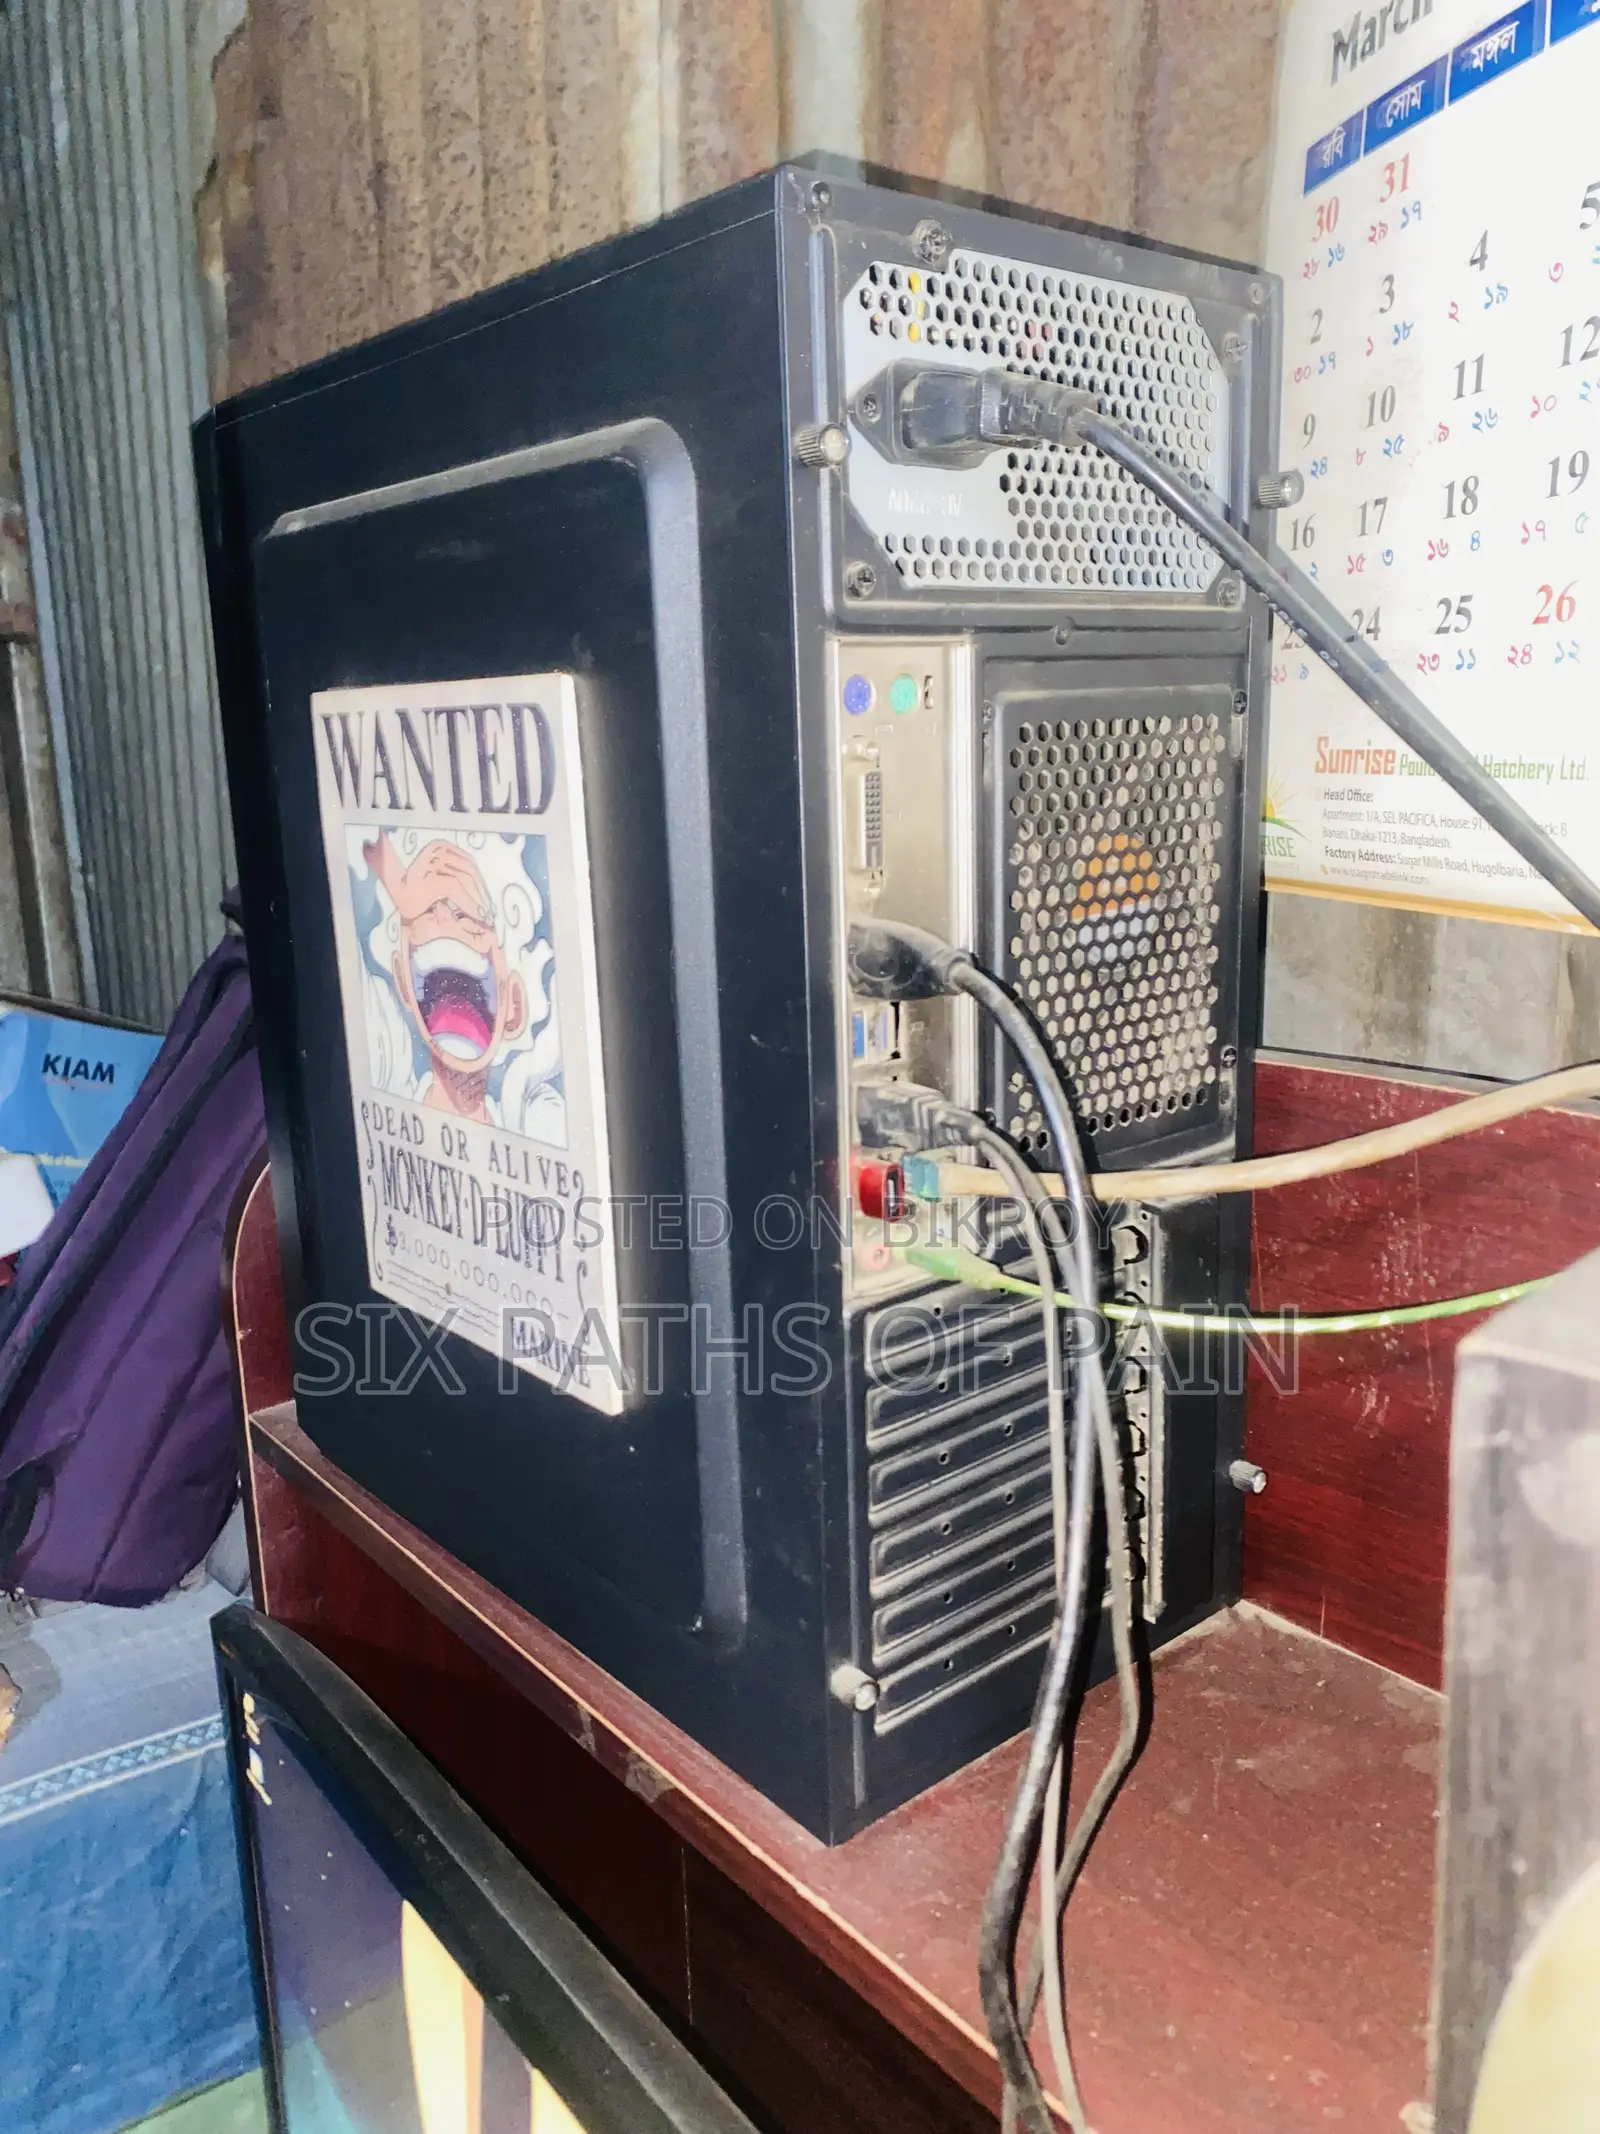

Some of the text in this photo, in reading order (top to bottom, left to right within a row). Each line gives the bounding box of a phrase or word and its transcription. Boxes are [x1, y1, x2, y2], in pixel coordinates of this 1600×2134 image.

[1310, 152, 1410, 242] 30 31
[1310, 180, 1600, 345] 2 3 4 5
[1302, 315, 1600, 450] 9 10 11 12
[1290, 450, 1590, 551] 16 17 18 19
[1434, 594, 1474, 635] 25
[1532, 579, 1579, 625] 26
[320, 702, 556, 815] WANTED
[1314, 736, 1396, 775] Sunrise
[1560, 755, 1589, 781] Ltd.
[1323, 787, 1374, 803] Head Office:
[1382, 811, 1397, 825] SEL
[1325, 846, 1356, 863] Factory
[1358, 849, 1397, 864] Address:
[42, 1053, 115, 1085] KIAM
[373, 1102, 569, 1199] DEAD OR ALIVE
